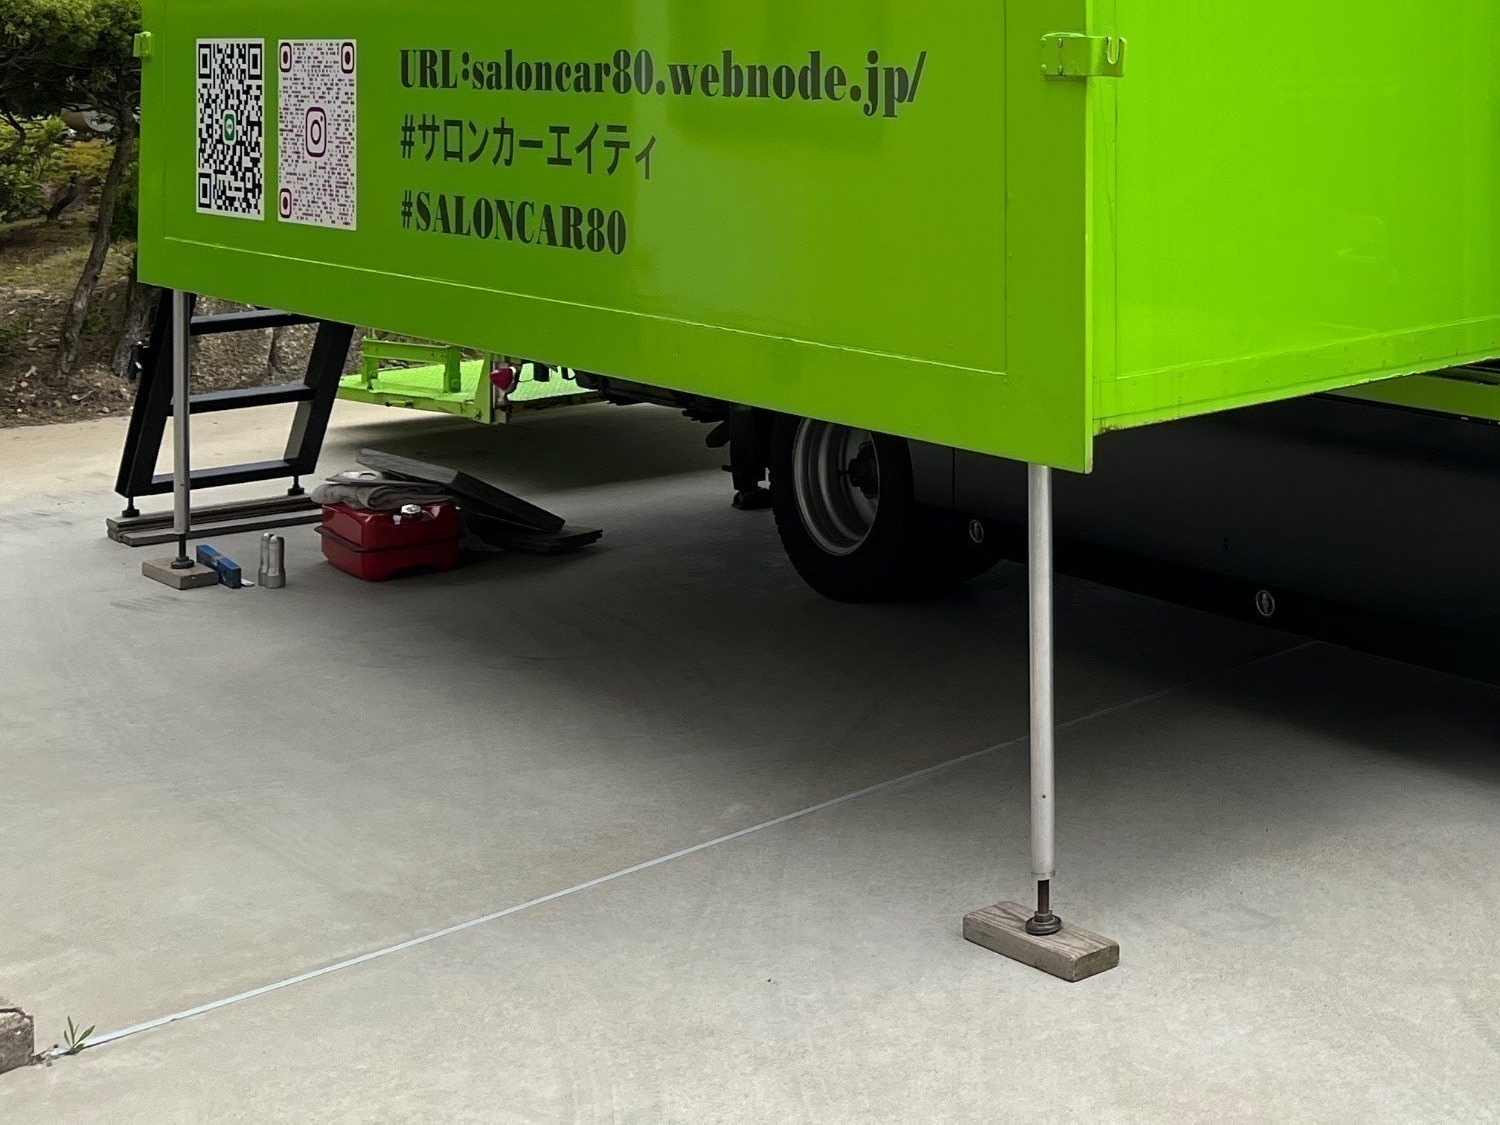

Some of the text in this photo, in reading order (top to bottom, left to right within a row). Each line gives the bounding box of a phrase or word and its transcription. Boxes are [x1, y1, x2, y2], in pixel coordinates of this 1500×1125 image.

[399, 48, 928, 119] URL:saloncar80.webnode.jp/
[400, 114, 657, 180] #サロンカーエイティ
[400, 190, 627, 255] #SALONCAR80
